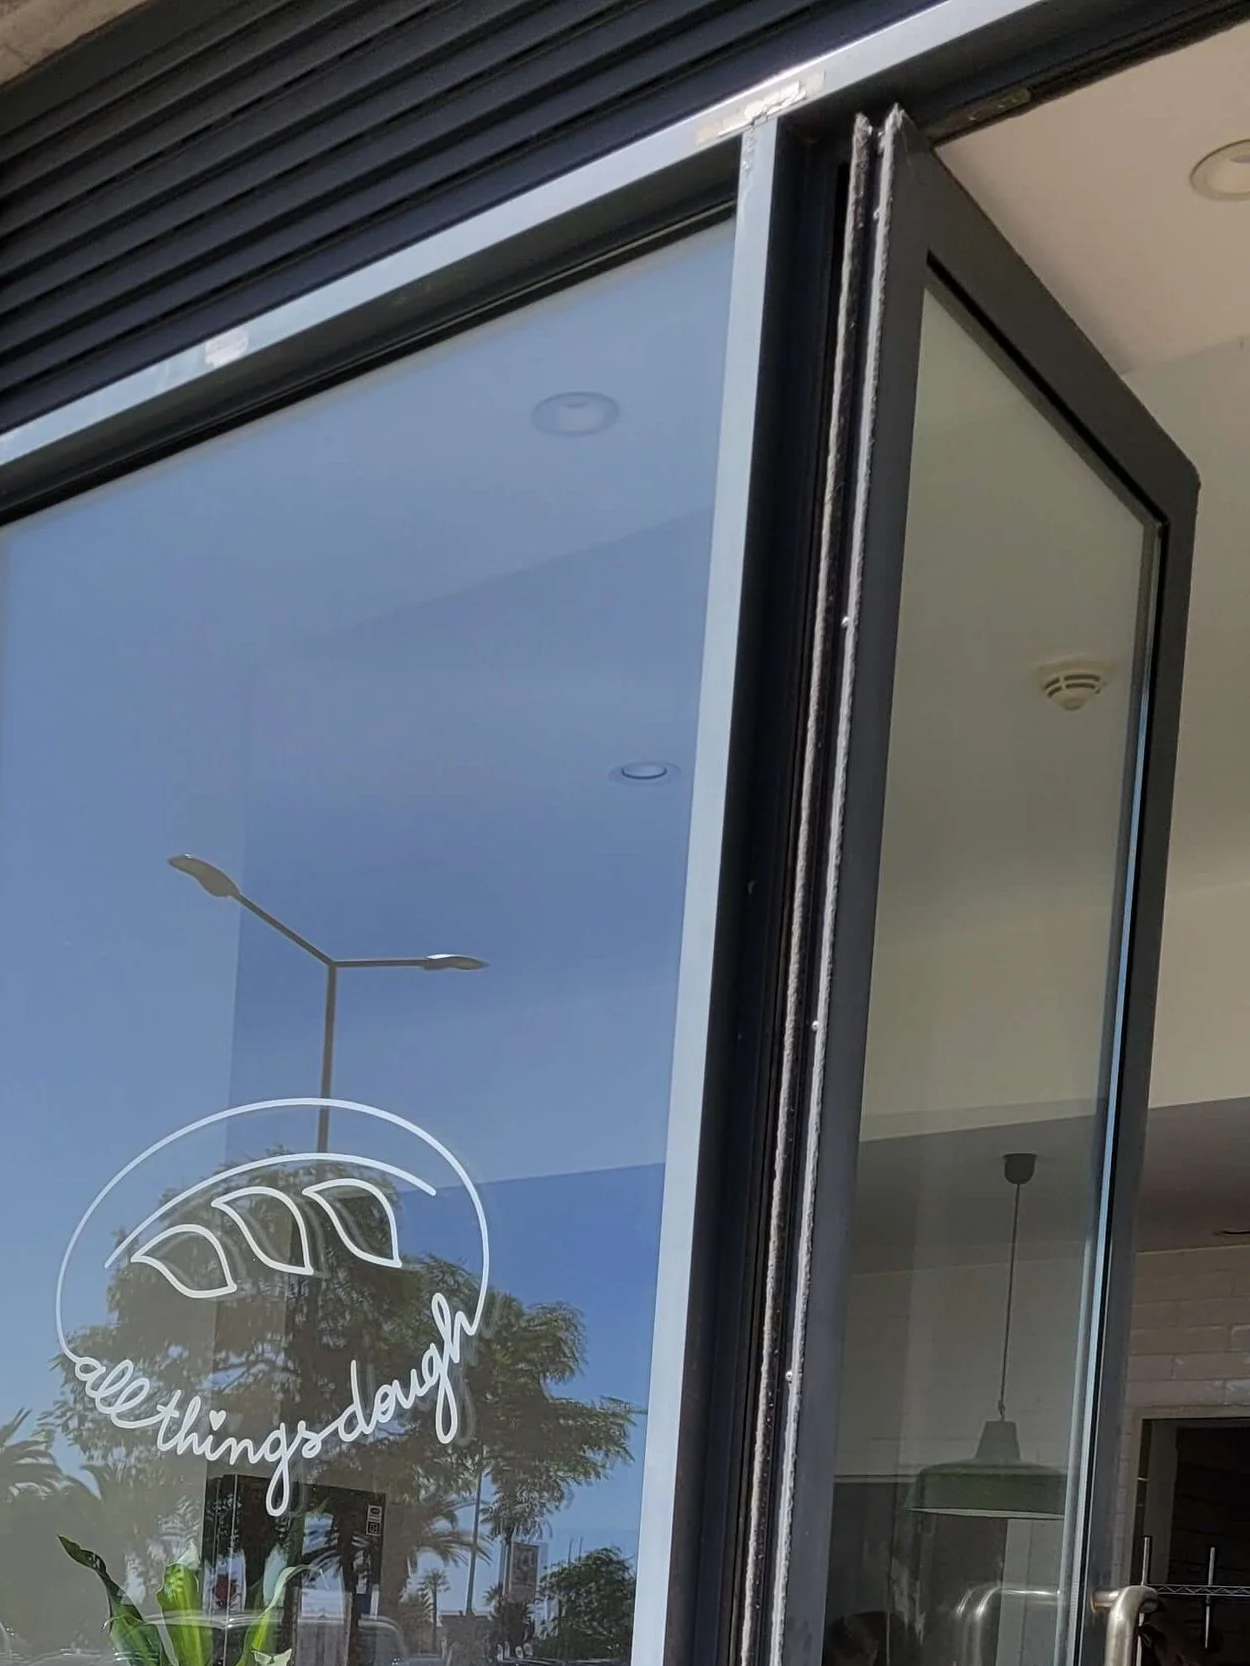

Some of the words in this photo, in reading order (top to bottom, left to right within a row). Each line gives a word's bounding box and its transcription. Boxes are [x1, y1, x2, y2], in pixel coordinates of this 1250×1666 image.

[74, 1357, 158, 1429] all
[155, 1389, 323, 1518] things
[329, 1292, 478, 1446] dough
